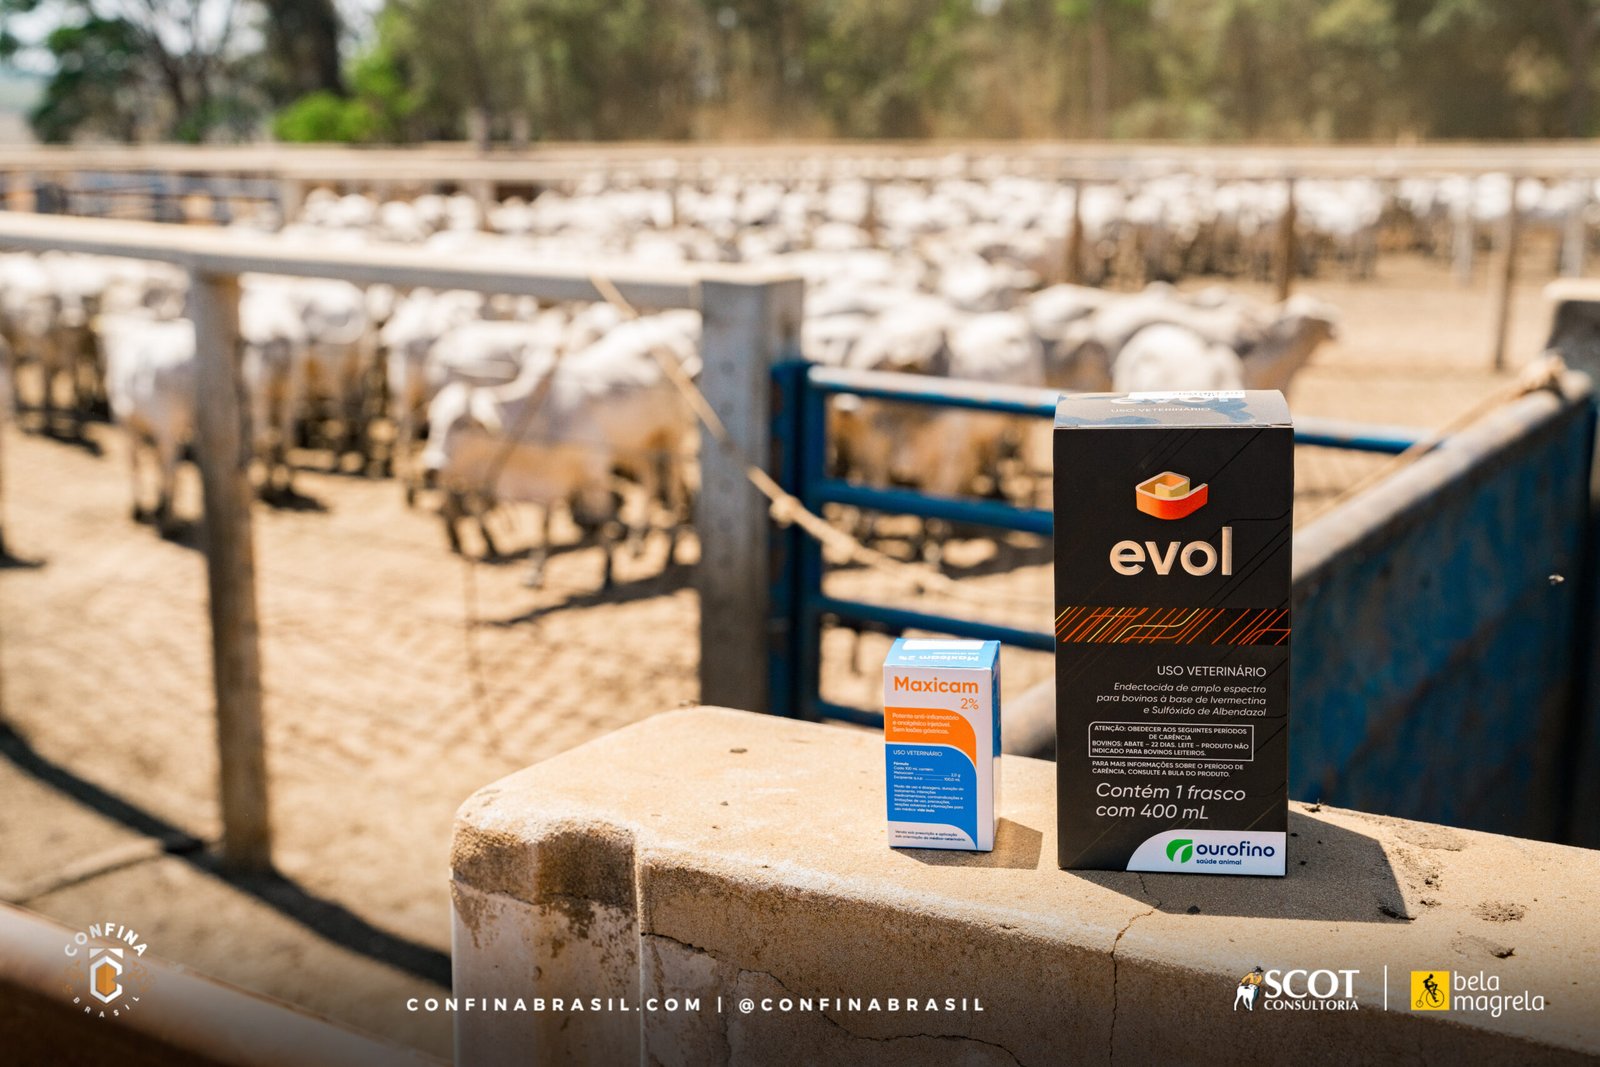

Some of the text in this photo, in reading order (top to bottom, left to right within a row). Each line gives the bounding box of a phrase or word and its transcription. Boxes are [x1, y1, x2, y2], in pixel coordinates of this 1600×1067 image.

[1110, 527, 1232, 576] evol
[1157, 665, 1266, 677] USO VETERINÁRIO
[894, 676, 979, 694] Maxicam
[1114, 683, 1174, 691] Endectocida
[1191, 684, 1221, 693] amplo
[1223, 686, 1266, 694] espectro
[961, 698, 979, 710] 2%
[1122, 694, 1158, 702] bovinos
[1210, 696, 1266, 705] Ivermectina
[1152, 706, 1195, 714] Sulfóxido
[1212, 707, 1266, 716] Albendazol
[1096, 782, 1246, 801] Contém 1 frasco
[1096, 804, 1209, 820] com 400 mL
[1196, 841, 1275, 857] ourofino
